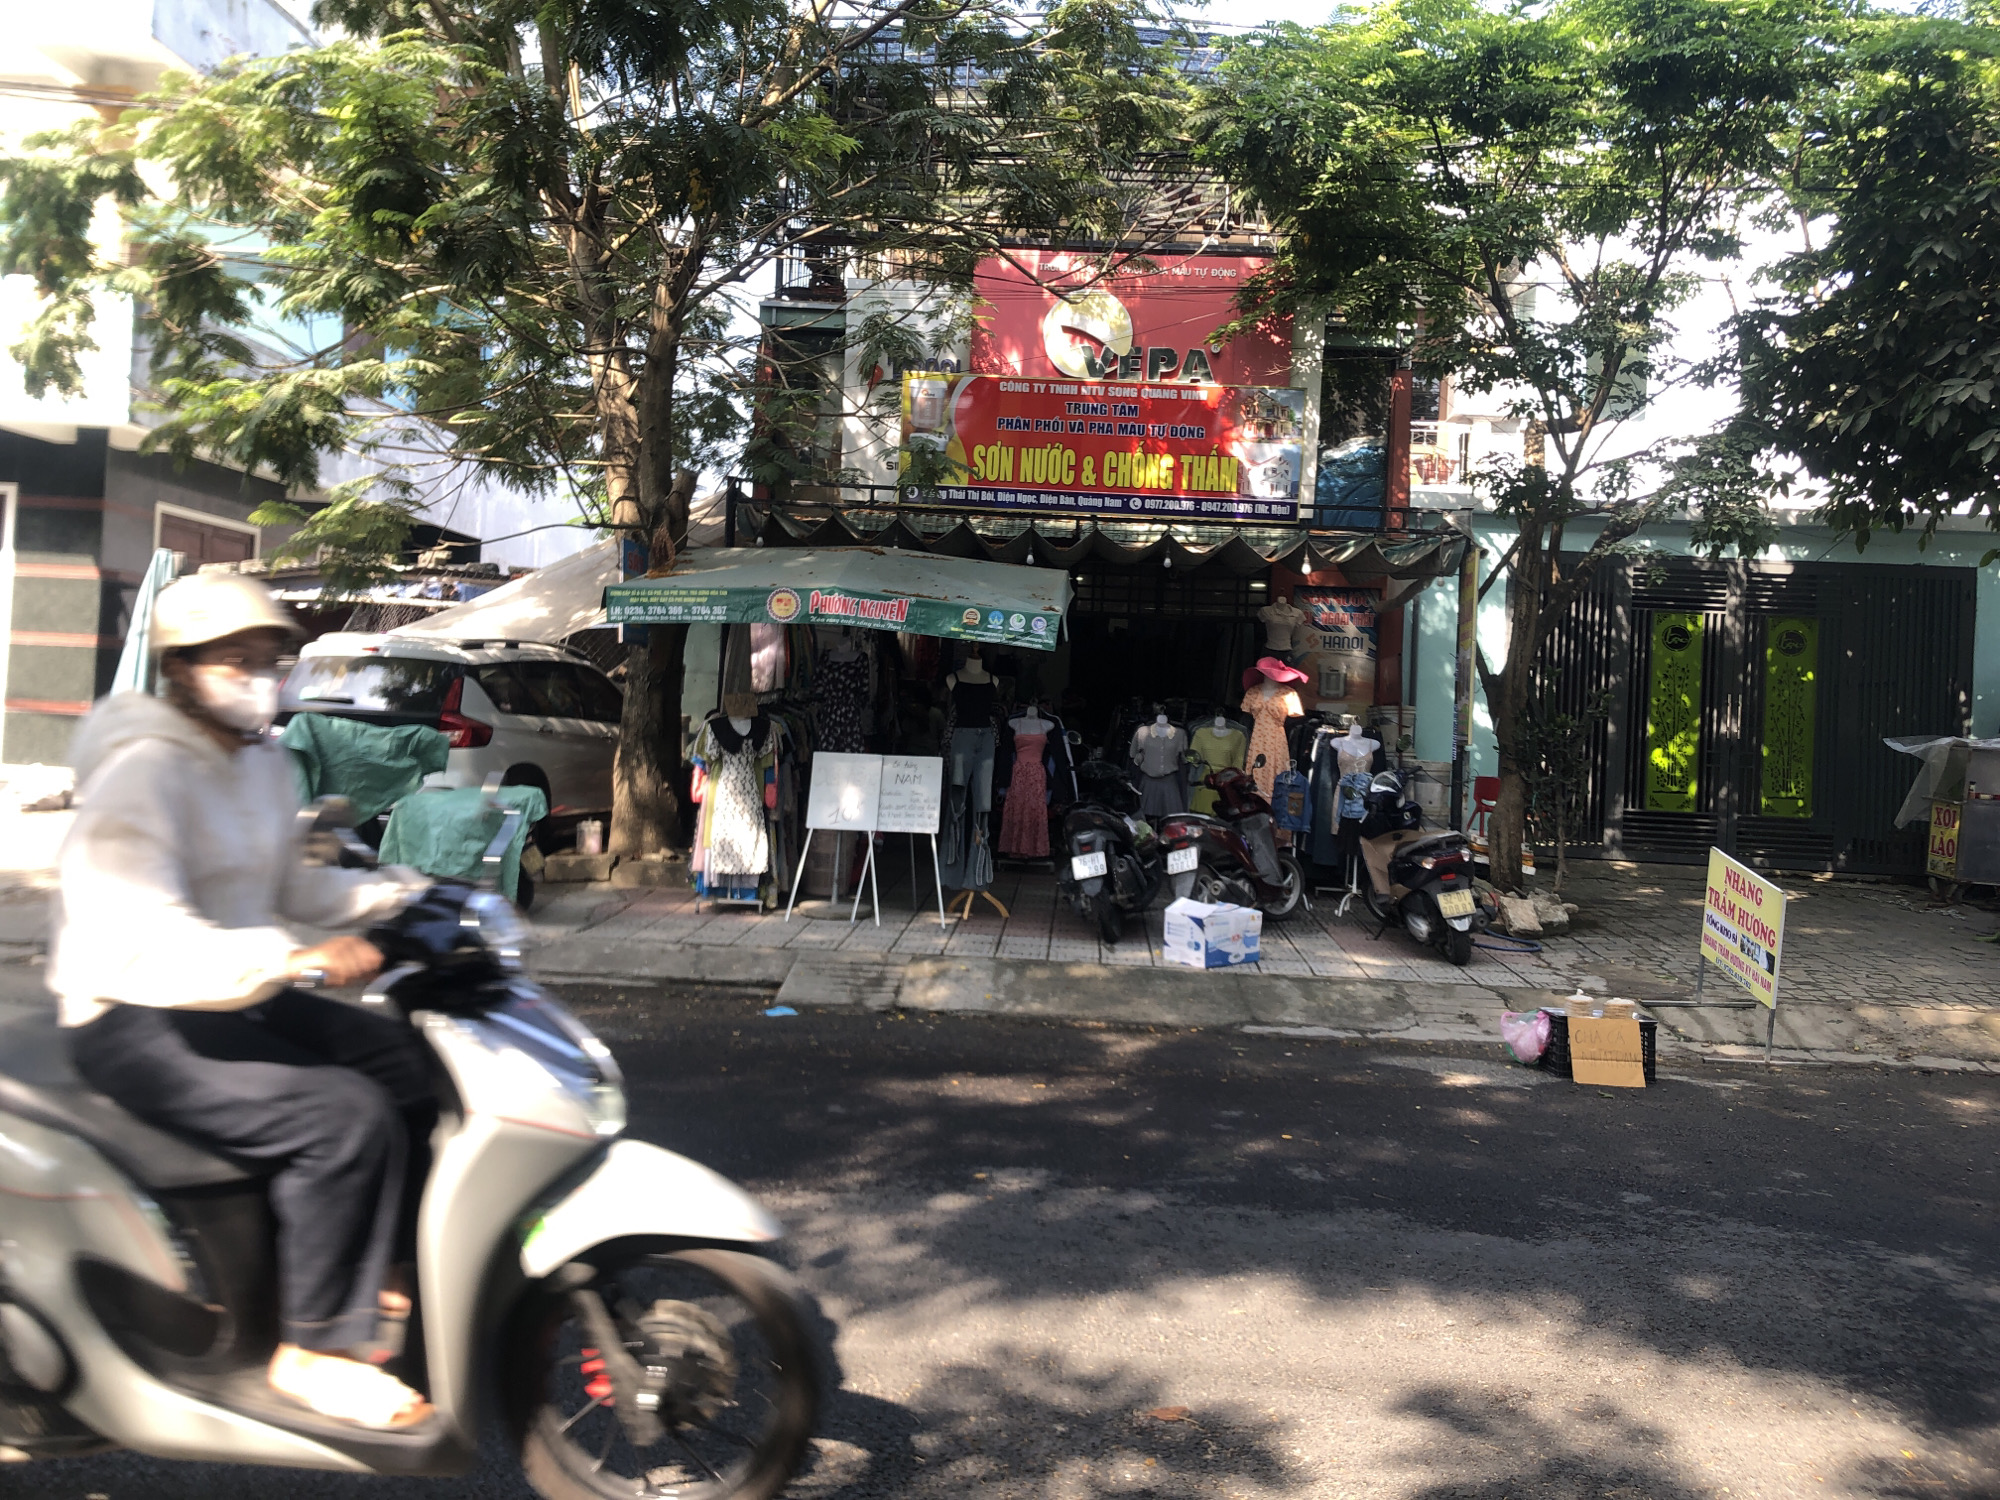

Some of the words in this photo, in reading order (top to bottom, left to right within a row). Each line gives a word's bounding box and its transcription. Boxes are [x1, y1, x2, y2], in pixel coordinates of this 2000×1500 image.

[1195, 267, 1209, 280] TỰ
[1211, 267, 1237, 281] ĐỘNG
[999, 380, 1030, 394] CÔNG
[1033, 382, 1046, 395] TY
[1049, 383, 1078, 397] TNHH
[1080, 385, 1105, 398] MTV
[1107, 385, 1138, 400] SONG
[1141, 388, 1177, 400] QUANG
[1180, 389, 1208, 401] VINH
[1065, 402, 1107, 417] TRUNG
[1112, 403, 1139, 418] TÂM
[997, 416, 1031, 431] PHÂN
[1034, 417, 1065, 433] PHỐI
[1068, 420, 1085, 434] VÀ
[1088, 421, 1114, 436] PHA
[1117, 422, 1146, 437] MÀU
[1150, 423, 1167, 439] TỰ
[1169, 424, 1205, 440] ĐỘNG
[972, 440, 1014, 482] SƠN
[1019, 443, 1076, 485] NƯỚC
[1081, 455, 1097, 486] &
[1103, 441, 1174, 490] CHỐNG
[1180, 443, 1239, 492] THẤM
[949, 488, 966, 500] Thái
[1104, 496, 1122, 507] Nam
[857, 598, 910, 622] NGUYÊN
[895, 773, 923, 785] NAM
[1933, 803, 1956, 828] XÔI
[1931, 831, 1955, 857] LÀO
[1725, 865, 1763, 907] NHANG
[1737, 907, 1776, 948] HƯƠNG
